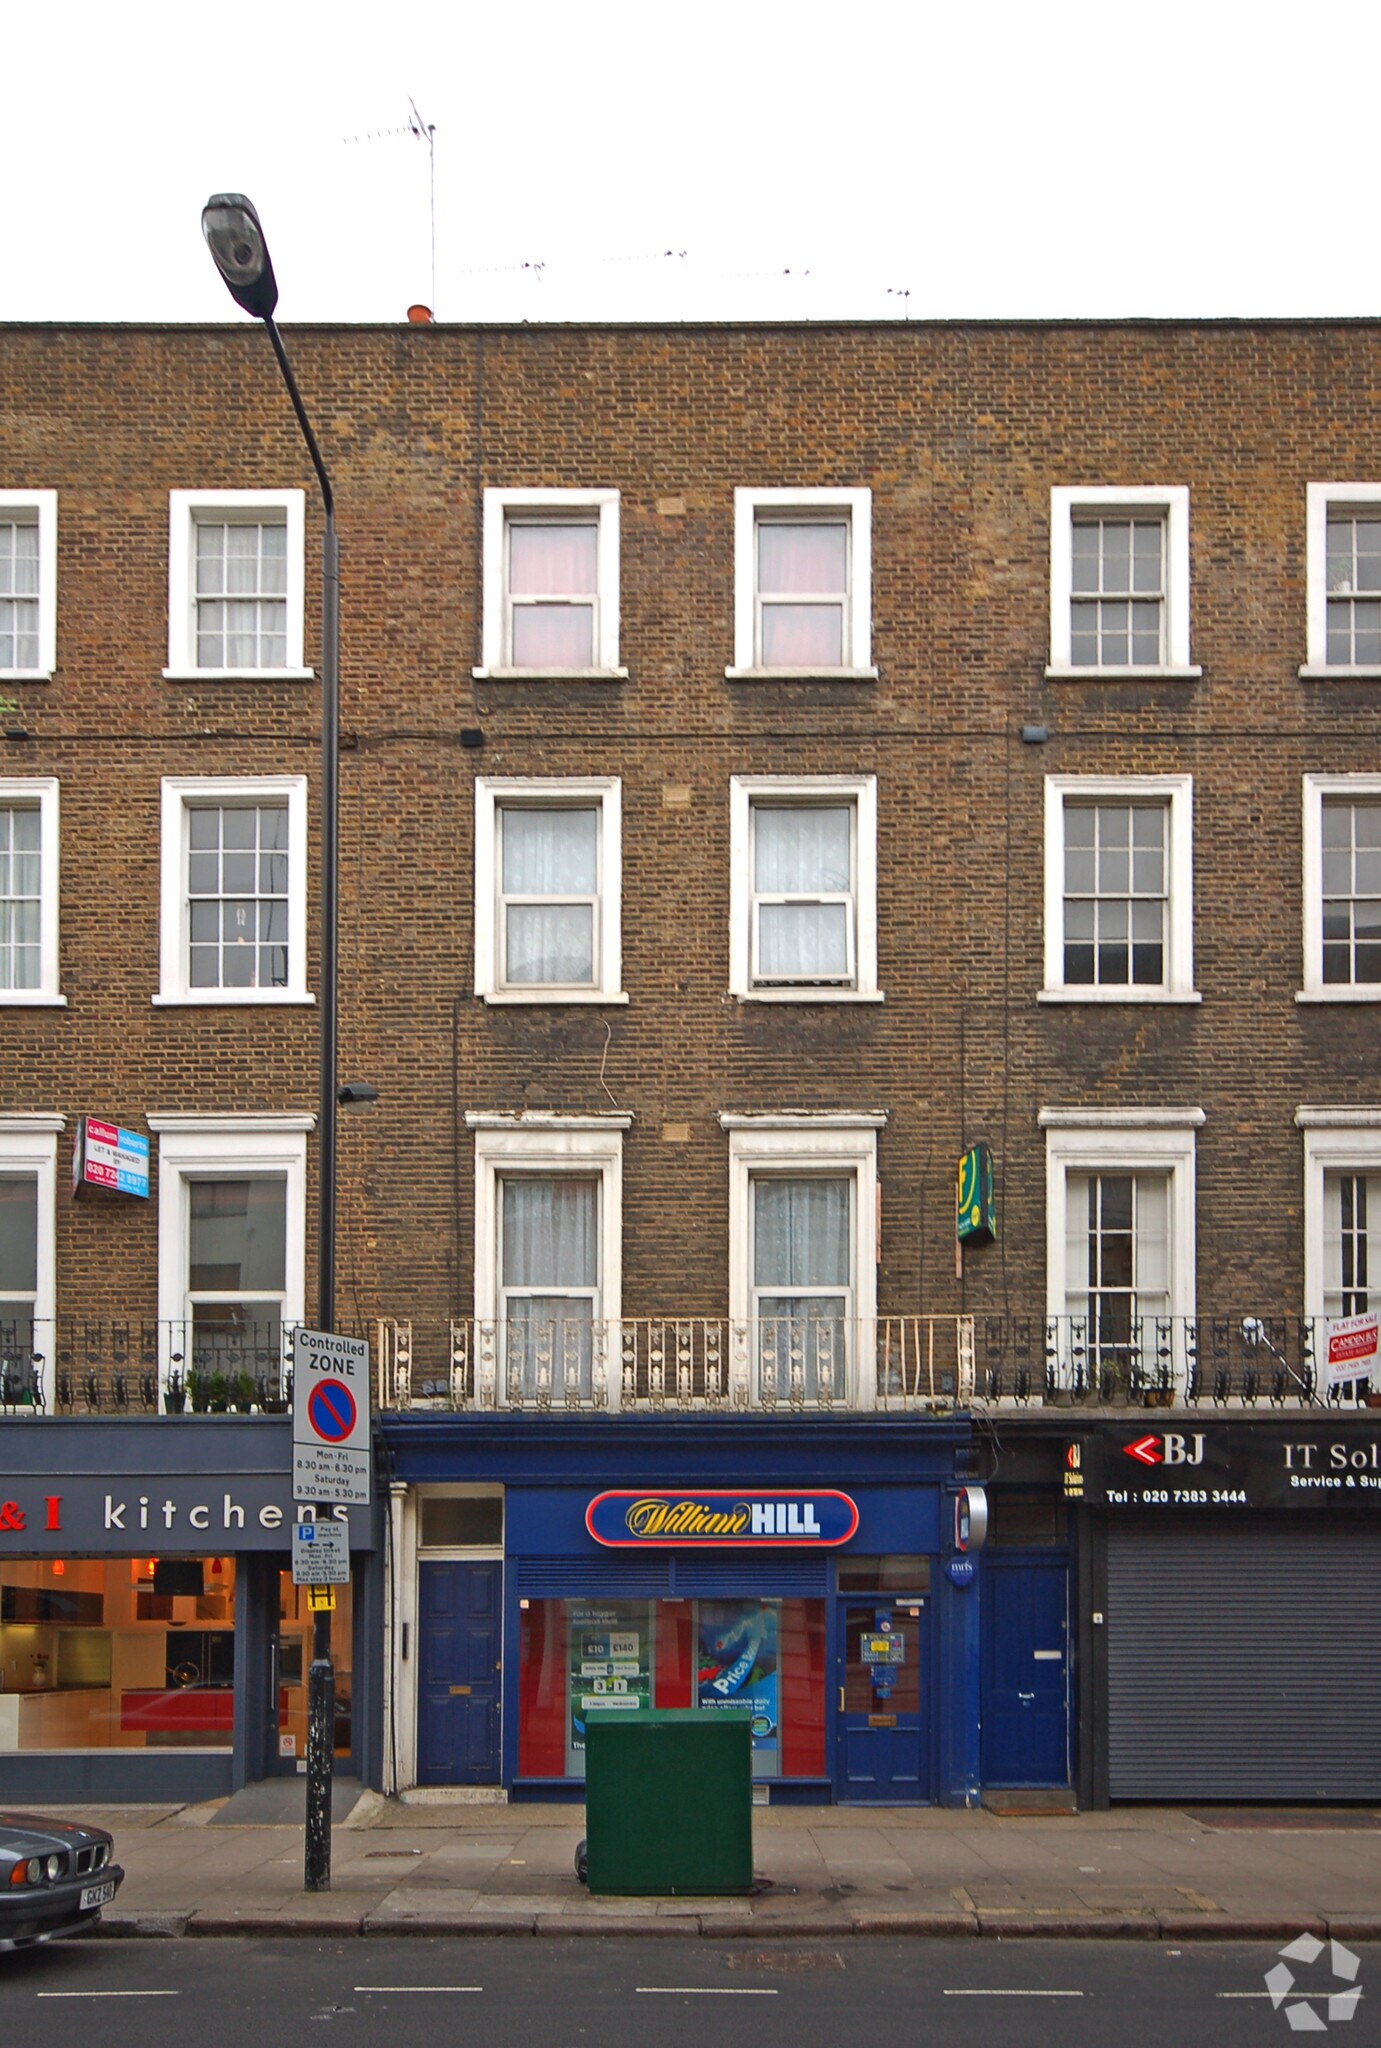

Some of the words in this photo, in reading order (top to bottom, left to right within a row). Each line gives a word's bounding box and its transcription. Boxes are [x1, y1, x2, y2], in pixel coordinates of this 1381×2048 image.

[87, 1162, 104, 1175] 020
[300, 1332, 365, 1357] Controlled
[309, 1353, 355, 1376] ZONE
[1162, 1433, 1207, 1465] BJ
[1283, 1443, 1318, 1469] IT
[297, 1460, 317, 1470] 8.30
[355, 1466, 367, 1475] pm
[315, 1474, 350, 1487] Saturday
[1290, 1475, 1342, 1488] Service
[1345, 1475, 1356, 1488] &
[297, 1485, 317, 1496] 9.30
[355, 1491, 367, 1500] pm
[1106, 1490, 1128, 1503] Tel
[1143, 1490, 1169, 1503] 020
[1173, 1490, 1208, 1503] 7383
[1212, 1490, 1247, 1503] 3444
[44, 1496, 63, 1531] I
[105, 1494, 349, 1530] kitchens
[624, 1498, 751, 1537] William
[752, 1503, 821, 1534] HILL
[613, 1644, 634, 1653] £140
[712, 1660, 749, 1695] Price
